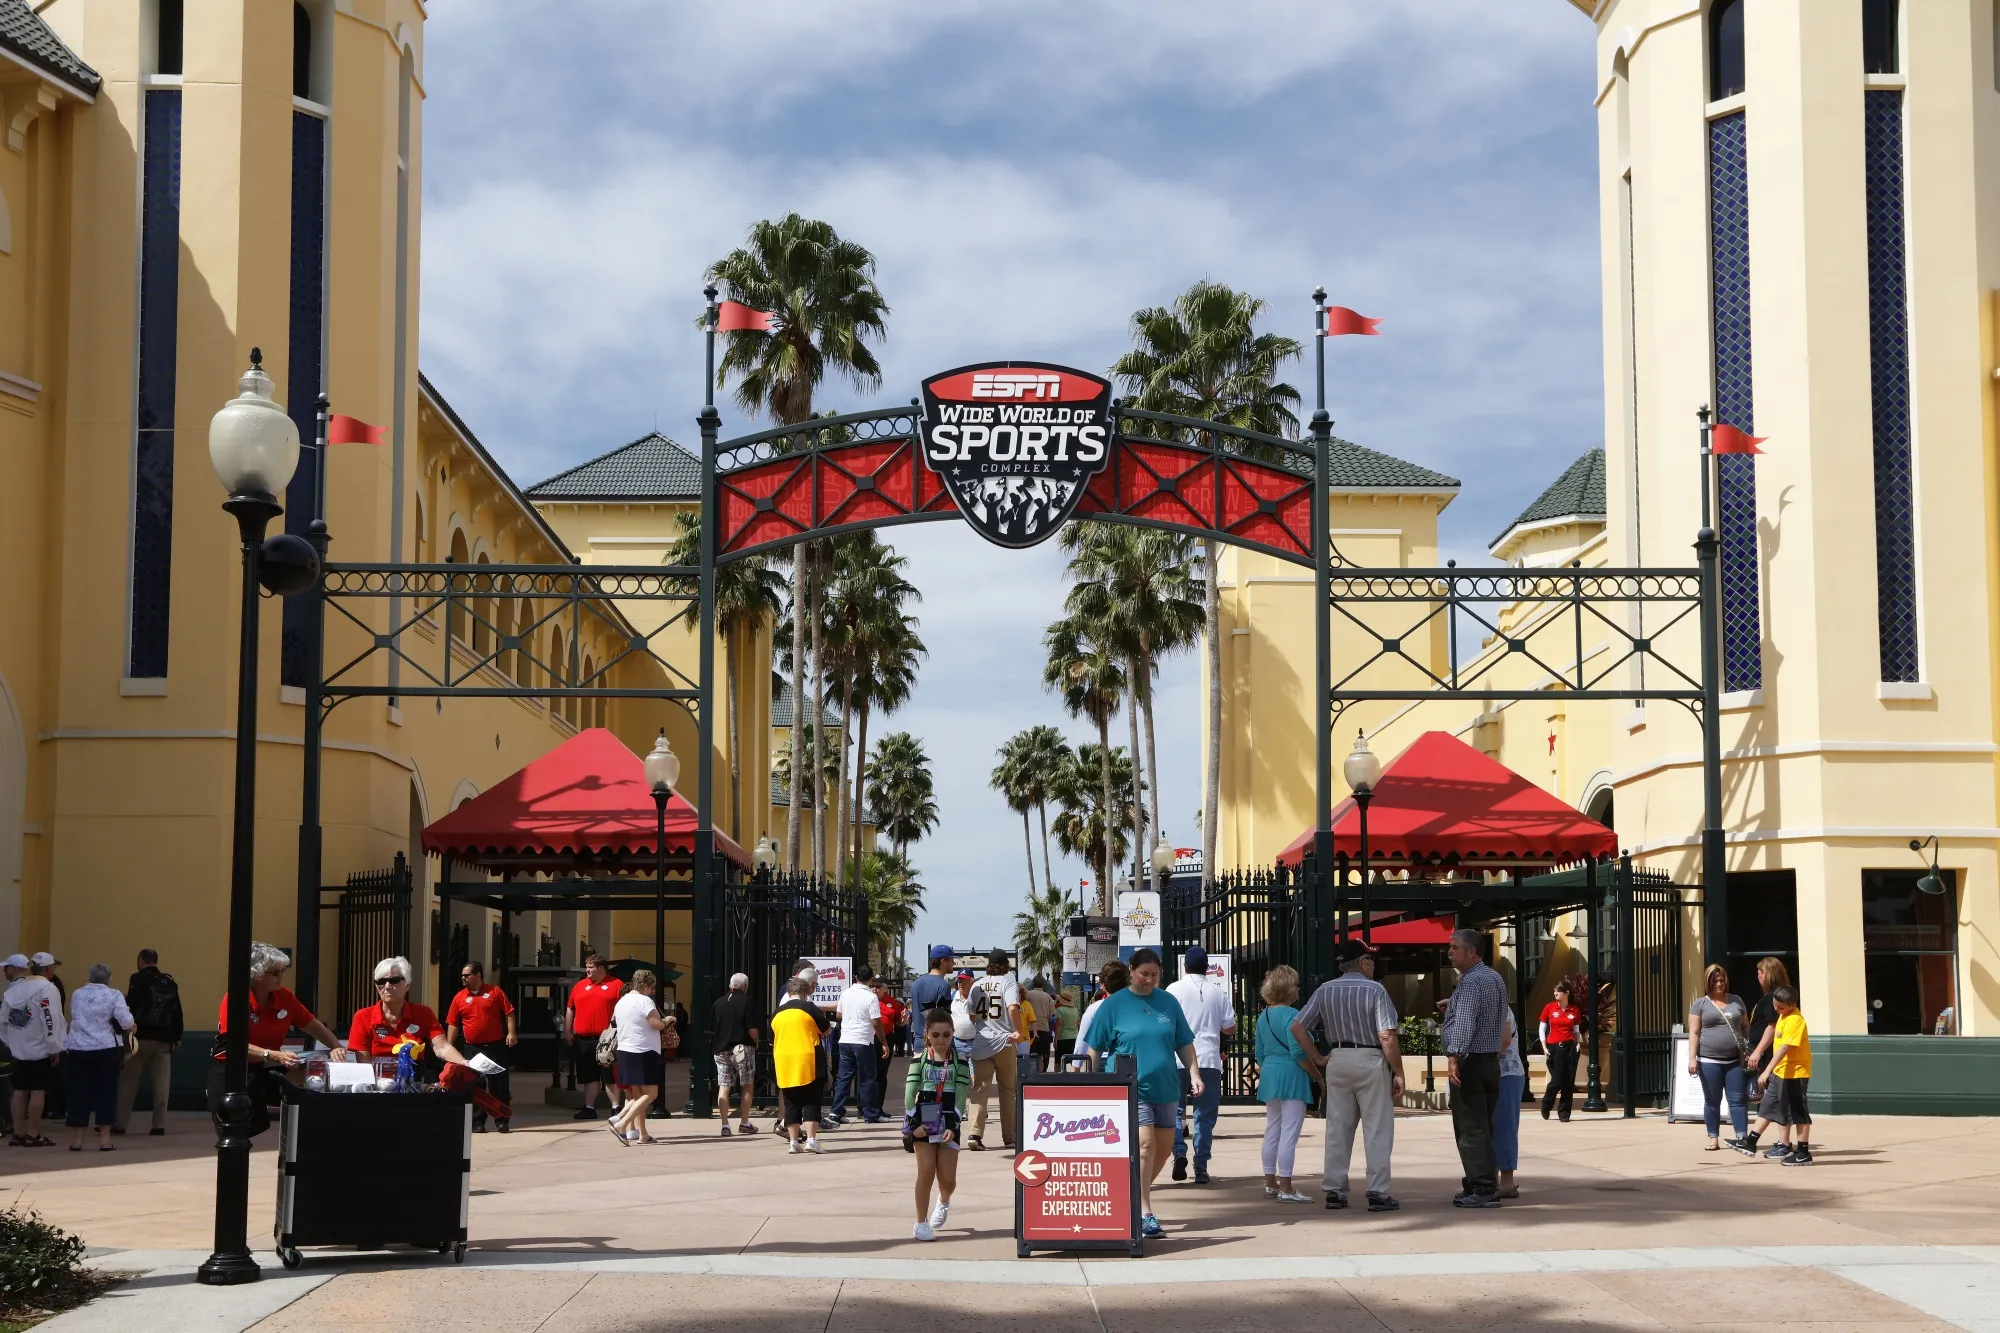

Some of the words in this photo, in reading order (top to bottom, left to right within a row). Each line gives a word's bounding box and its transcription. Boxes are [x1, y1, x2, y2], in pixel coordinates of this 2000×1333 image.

[971, 374, 1061, 398] ESPN
[938, 404, 994, 424] WIDE
[998, 404, 1071, 424] WORLD
[1073, 409, 1096, 424] OF
[929, 425, 1106, 462] SPORTS
[980, 464, 1051, 473] COMPLEX
[976, 995, 1002, 1020] 45
[1034, 1112, 1105, 1141] Braves
[1051, 1162, 1067, 1177] ON
[1069, 1162, 1102, 1177] FIELD
[1044, 1181, 1108, 1197] SPECTATOR
[1042, 1201, 1112, 1216] EXPERIENCE
